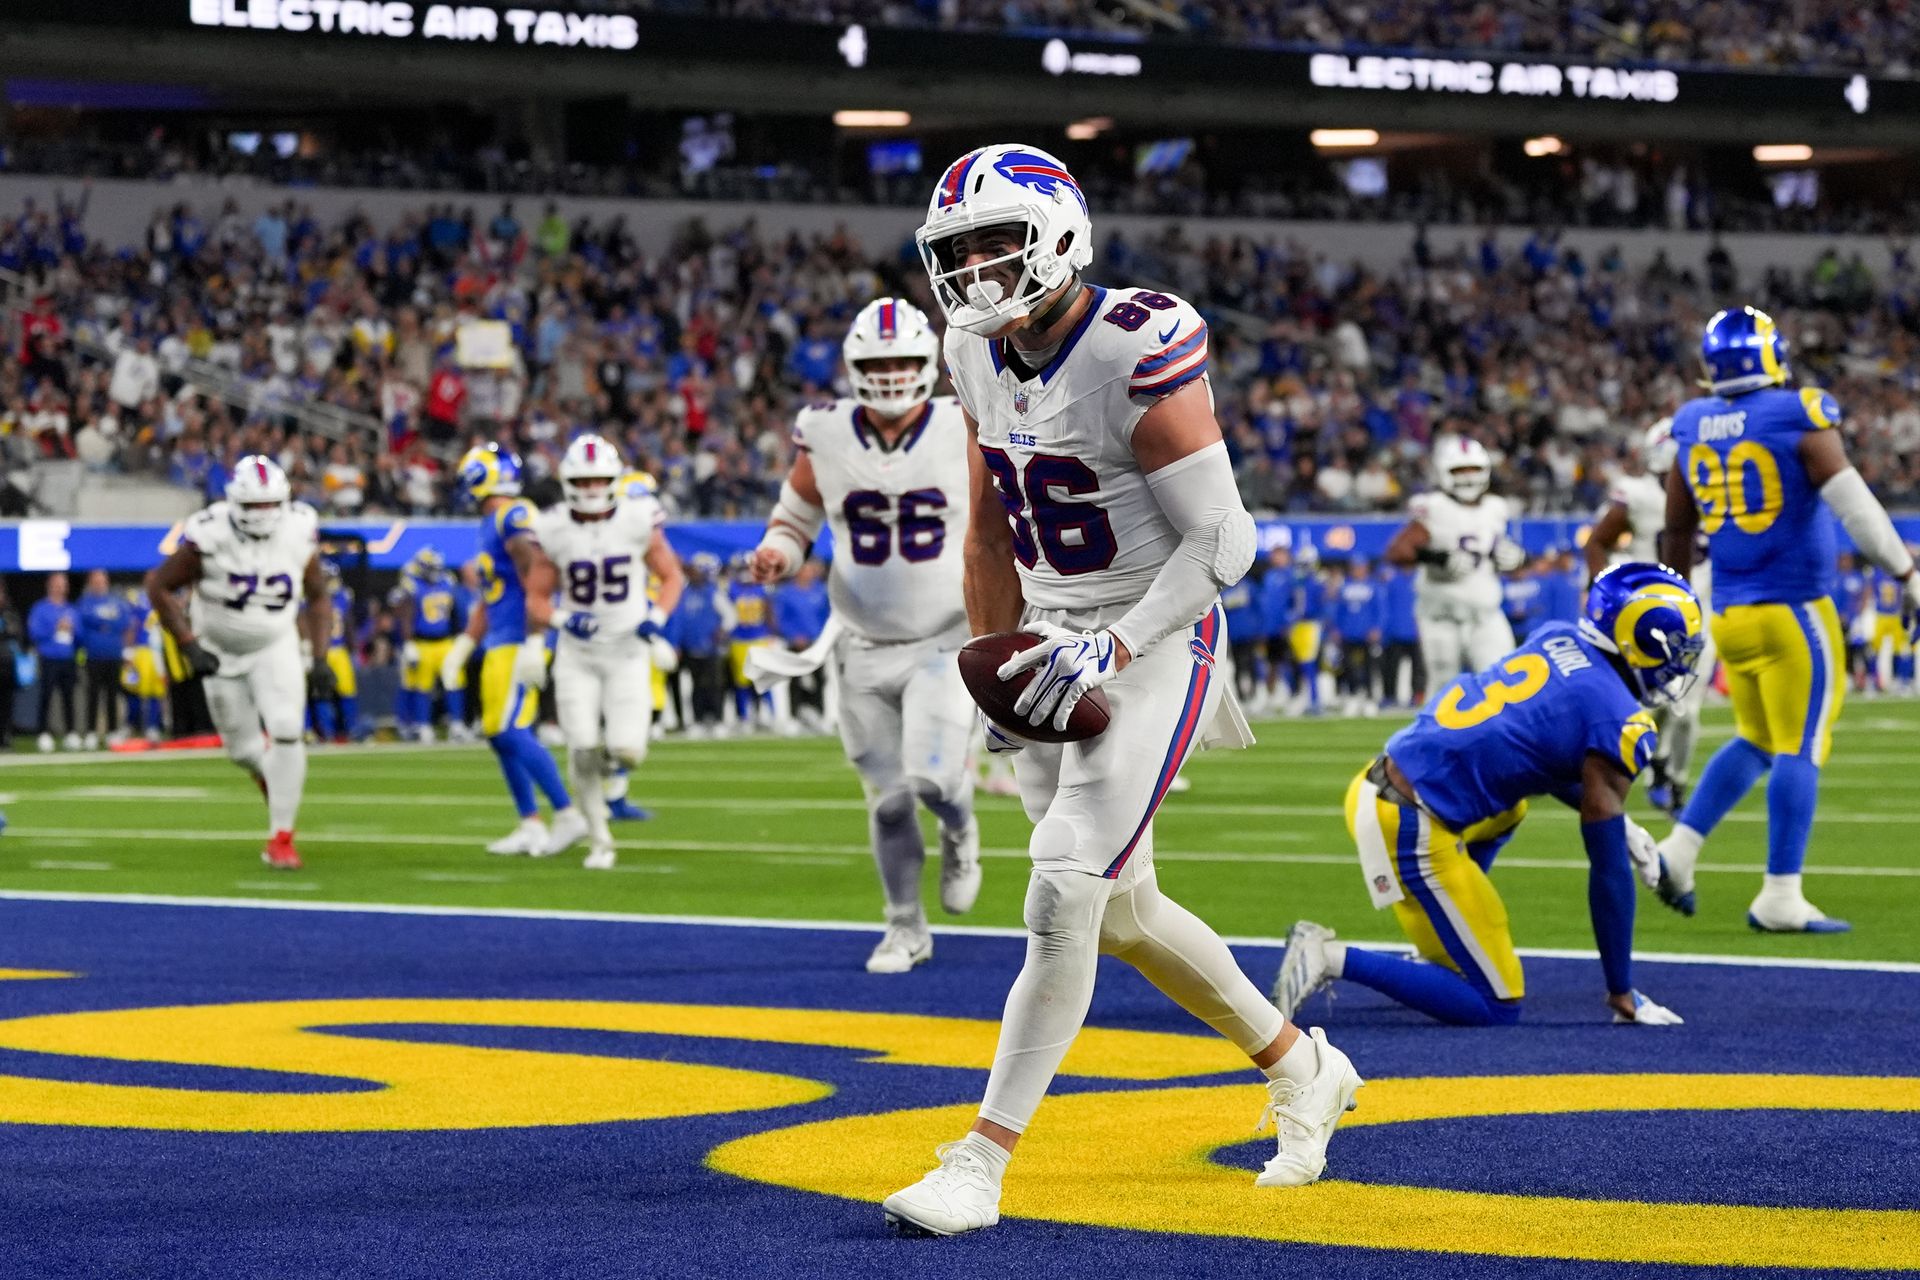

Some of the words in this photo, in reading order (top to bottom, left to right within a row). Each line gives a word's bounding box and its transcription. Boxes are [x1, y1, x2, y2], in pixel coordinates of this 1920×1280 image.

[190, 0, 414, 37] ELECTRIC
[422, 5, 499, 41] AIR
[504, 9, 639, 49] TAXIS
[1310, 54, 1493, 93] ELECTRIC
[1499, 63, 1562, 97] AIR
[1566, 66, 1679, 101] TAXIS
[1103, 291, 1177, 332] 86
[1009, 432, 1037, 447] BILLS
[978, 443, 1118, 576] 86
[1688, 440, 1784, 534] 90
[843, 487, 947, 567] 66
[225, 573, 293, 612] 73
[567, 555, 631, 604] 85
[1542, 635, 1593, 678] CURL
[1434, 652, 1551, 730] 3
